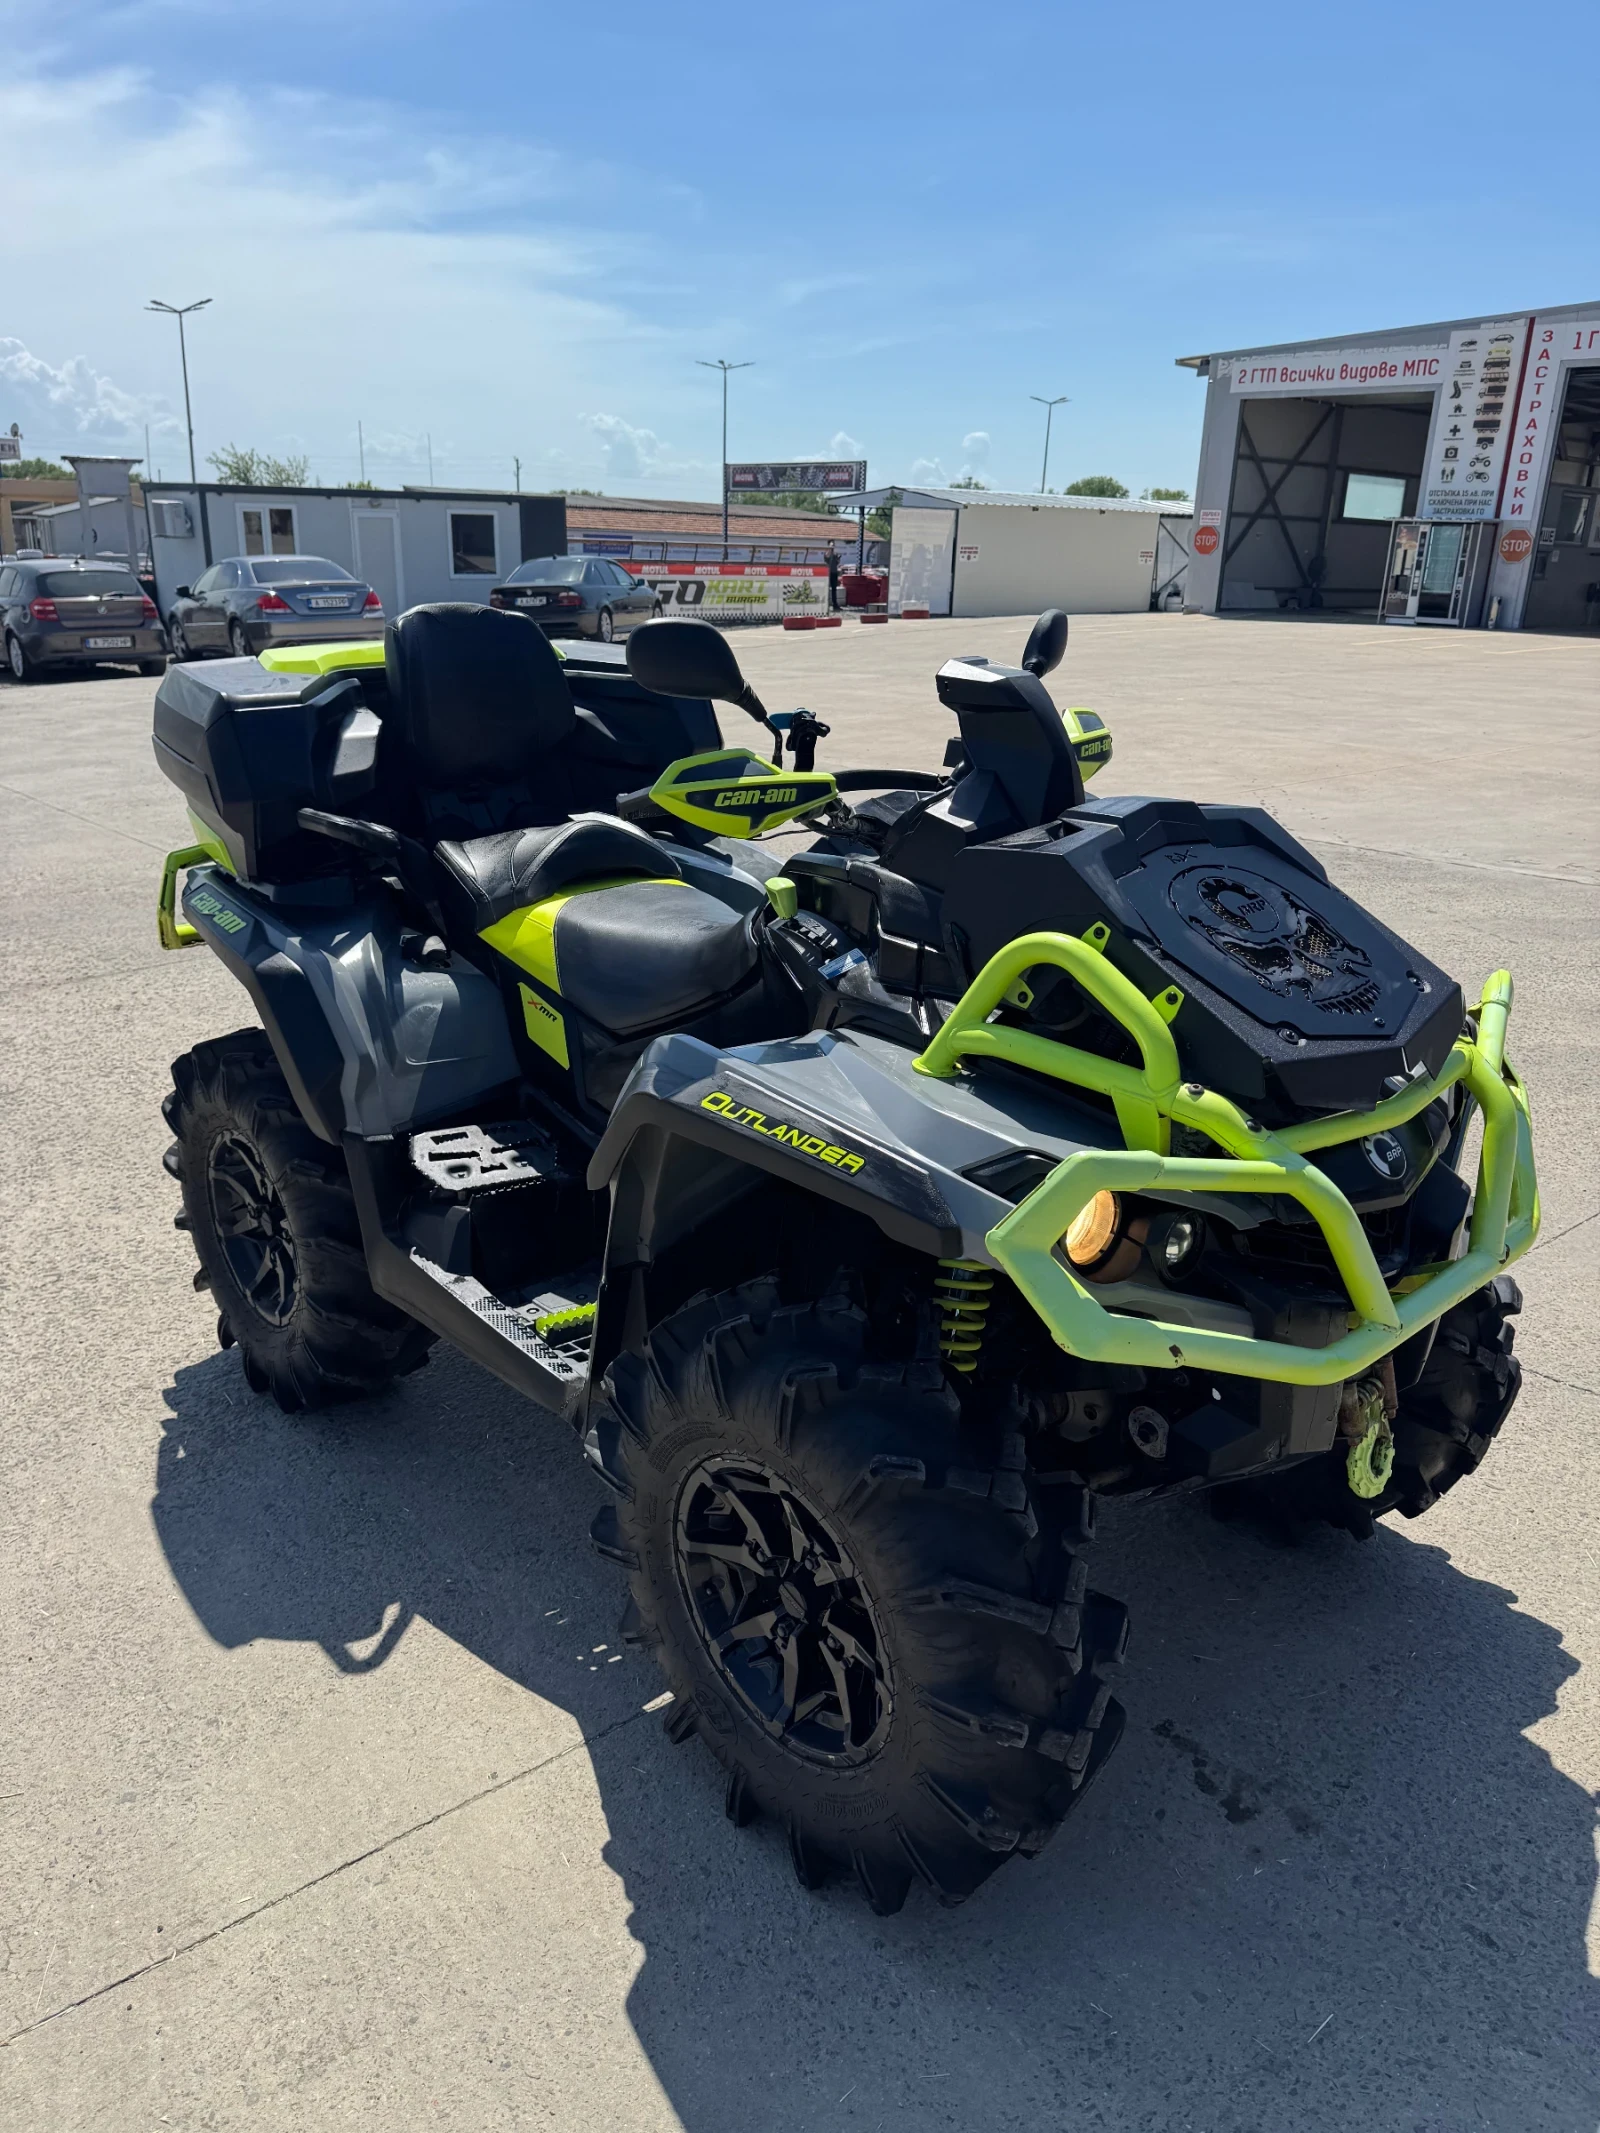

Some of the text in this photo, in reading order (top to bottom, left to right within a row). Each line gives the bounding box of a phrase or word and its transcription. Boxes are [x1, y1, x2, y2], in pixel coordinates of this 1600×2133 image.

[1572, 331, 1583, 350] 1
[1238, 369, 1247, 384] 2
[1250, 367, 1277, 383] ГТП
[1402, 358, 1440, 377] МПС
[1510, 330, 1554, 515] ЗАСТРАХОВКИ
[1195, 534, 1217, 546] STOP
[1501, 540, 1531, 552] STOP
[641, 565, 669, 575] MOTUL
[695, 565, 720, 575] MOTUL
[744, 566, 767, 576] MOTUL
[790, 567, 814, 576] MOTUL
[705, 579, 770, 594] KART
[725, 595, 770, 604] BURGAS
[1080, 739, 1111, 758] can-a
[714, 787, 798, 807] can-am
[190, 891, 247, 934] can-am
[1237, 899, 1266, 917] BRP
[700, 1090, 865, 1173] OUTLANDER
[1386, 1146, 1402, 1162] BRP
